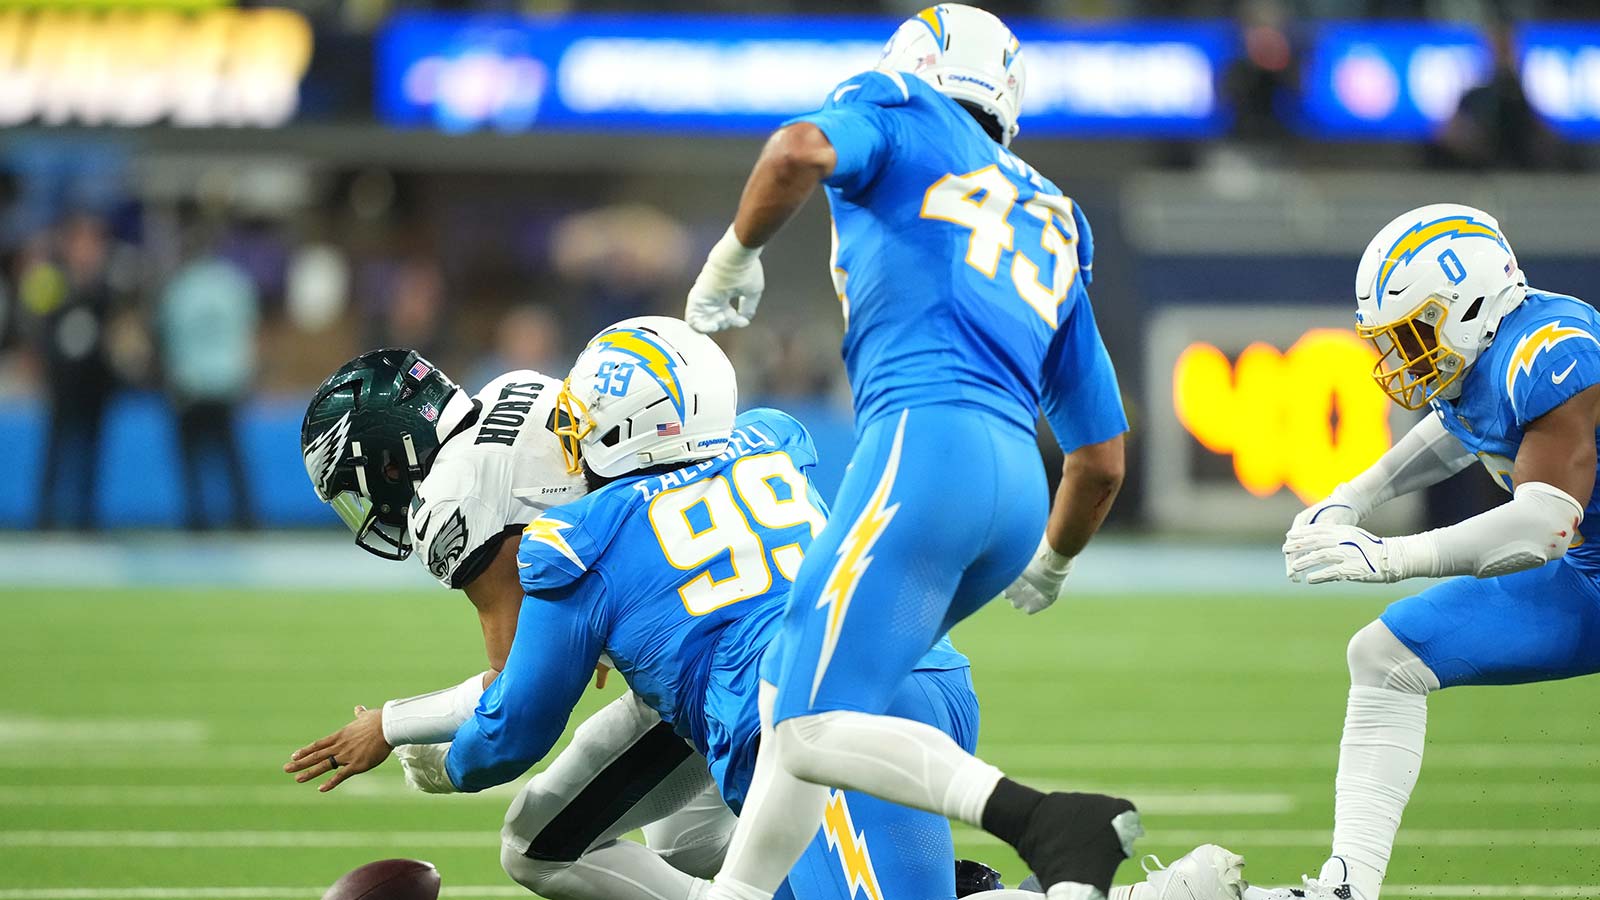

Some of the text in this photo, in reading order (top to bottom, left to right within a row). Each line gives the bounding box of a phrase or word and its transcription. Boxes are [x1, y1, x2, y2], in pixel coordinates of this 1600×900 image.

[919, 163, 1079, 330] 43
[1437, 248, 1467, 286] 0
[594, 361, 635, 397] 99
[474, 382, 545, 447] HURTS
[648, 451, 829, 616] 99
